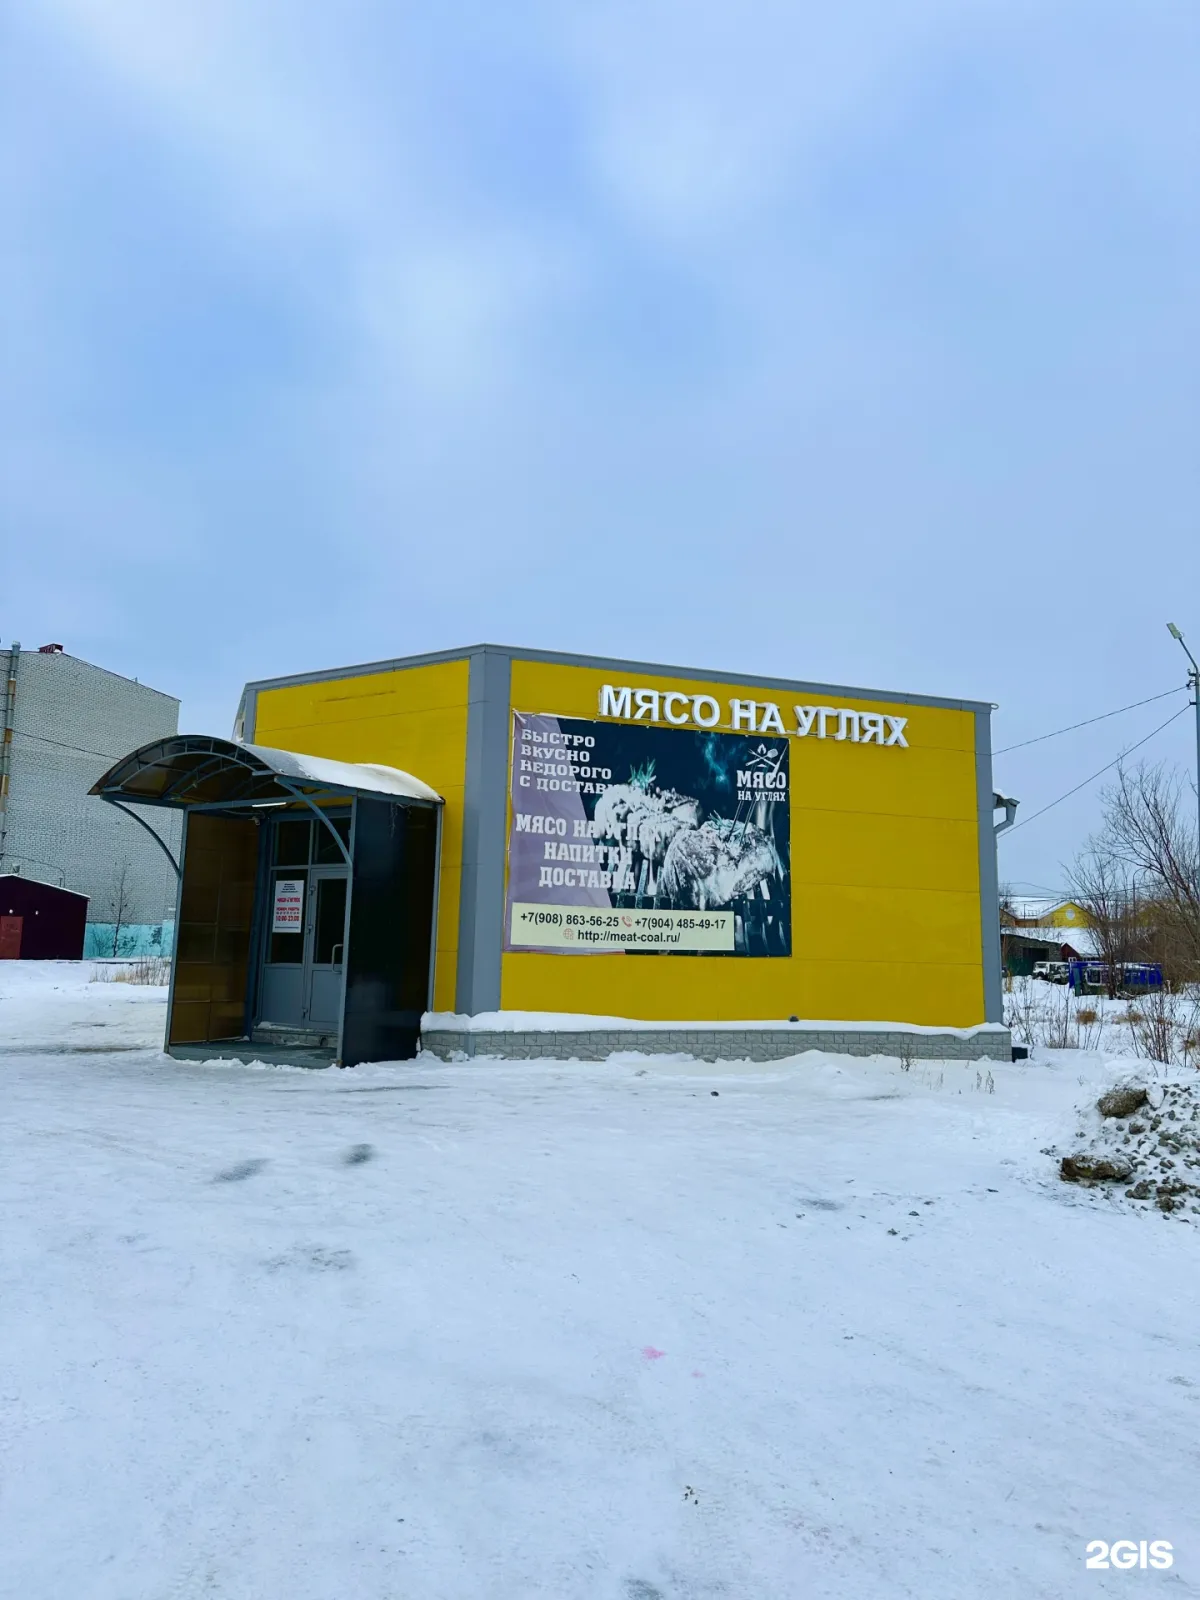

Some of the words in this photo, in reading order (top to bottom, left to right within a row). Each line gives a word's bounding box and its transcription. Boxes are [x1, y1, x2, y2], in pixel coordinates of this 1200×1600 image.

[599, 684, 720, 728] МЯСО
[731, 699, 787, 735] НА
[794, 705, 910, 748] УГЛЯХ
[521, 729, 595, 748] БЫСТРО
[521, 744, 590, 763] ВКУСНО
[520, 760, 612, 780] НЕДОРОГО
[736, 770, 787, 789] МЯСО
[519, 775, 531, 788] С
[737, 790, 752, 801] НА
[516, 813, 567, 837] МЯСО
[544, 841, 633, 865] НАПИТКИ
[520, 911, 563, 927] +7(908)
[566, 914, 619, 927] 863-56-25
[635, 917, 674, 931] +7(904)
[677, 918, 726, 930] 485-49-17
[577, 929, 681, 943] http://meat-coal.ru/
